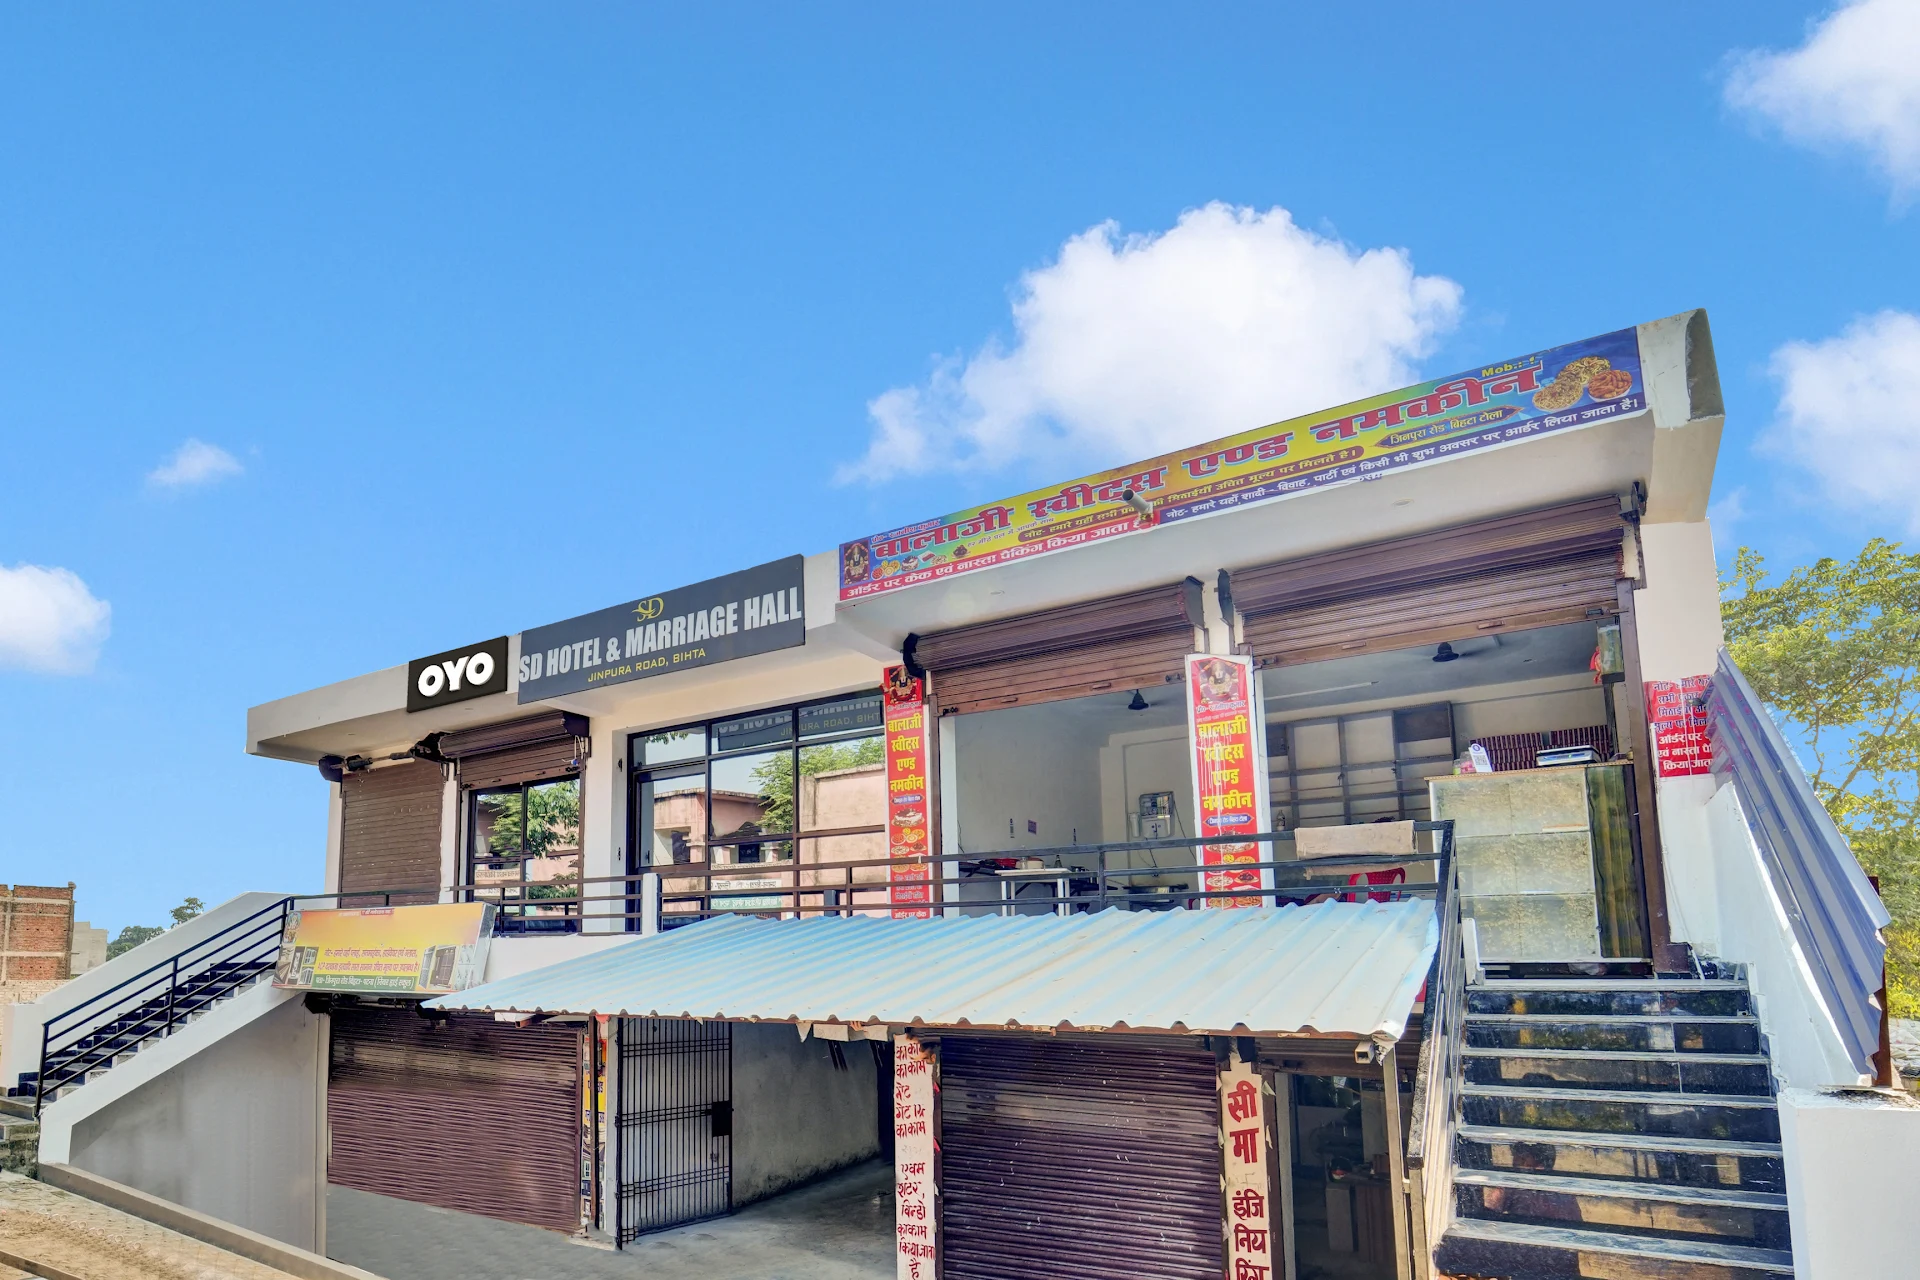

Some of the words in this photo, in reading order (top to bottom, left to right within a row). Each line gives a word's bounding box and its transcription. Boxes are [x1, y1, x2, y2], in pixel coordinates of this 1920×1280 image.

[1390, 427, 1427, 447] जिनपुरा
[1430, 423, 1445, 435] रोड
[1450, 415, 1477, 430] बिहटा
[1479, 408, 1503, 422] टोला
[871, 506, 1015, 560] बालाजी
[1181, 432, 1294, 479] एण्ड
[1309, 359, 1544, 443] नमकीन
[1191, 498, 1217, 513] हमारे
[1313, 466, 1341, 483] पार्टी
[1341, 464, 1356, 476] एवं
[1359, 456, 1390, 472] किसी
[1393, 451, 1408, 464] भी
[1412, 447, 1435, 461] शुभ
[1439, 435, 1479, 453] अवसर
[1482, 431, 1501, 443] पर
[1543, 411, 1578, 429] लिया
[1582, 403, 1617, 420] जाता
[1216, 477, 1244, 494] उचित
[1249, 469, 1275, 485] मूल्य
[1279, 463, 1295, 475] पर
[1299, 454, 1335, 472] मिलते
[847, 581, 881, 598] ऑर्डर
[883, 576, 902, 591] पर
[904, 568, 933, 586] केक
[935, 562, 954, 579] एवं
[957, 554, 997, 574] नास्ता
[1047, 532, 1087, 549] किया
[1091, 520, 1129, 538] जाता
[518, 652, 543, 683] SD
[546, 639, 602, 677] HOTEL
[605, 637, 621, 663] &
[625, 601, 738, 659] MARRIAGE
[744, 586, 802, 631] HALL
[417, 651, 496, 698] OYO
[587, 664, 633, 683] JINPURA
[635, 656, 669, 673] ROAD,
[673, 648, 706, 665] BIHTA
[887, 712, 923, 733] बालाजी
[1197, 714, 1248, 739] बालाजी
[891, 734, 920, 753] स्वीट्स
[1688, 732, 1703, 741] पर
[896, 757, 916, 772] एण्ड
[890, 774, 924, 792] नमकीन
[1212, 768, 1240, 786] एण्ड
[1202, 789, 1252, 811] नमकीन
[901, 1199, 926, 1221] विन्डो
[908, 1257, 921, 1280] है
